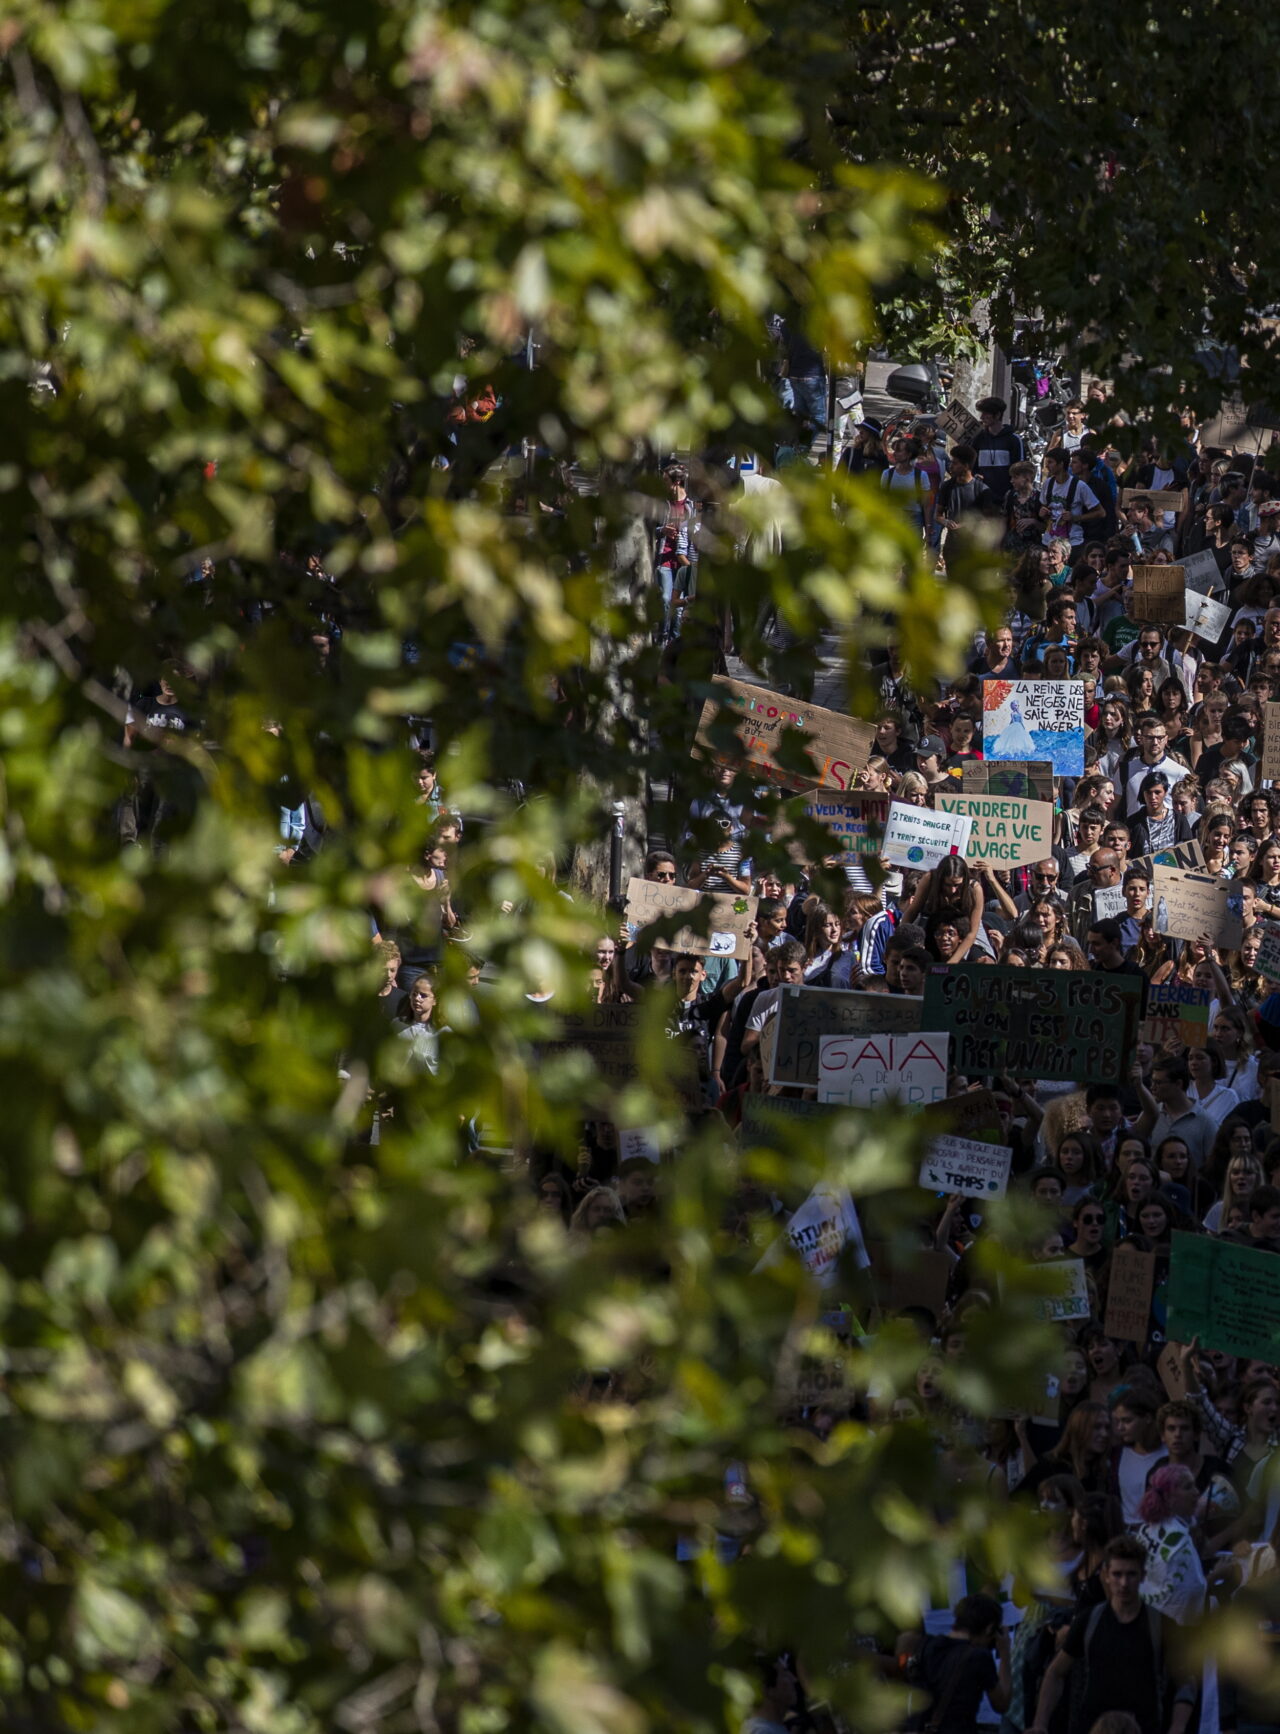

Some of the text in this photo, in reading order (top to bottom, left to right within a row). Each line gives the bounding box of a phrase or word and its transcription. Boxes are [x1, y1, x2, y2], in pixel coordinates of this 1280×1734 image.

[1015, 681, 1029, 695] LA
[1068, 699, 1084, 710] NE
[742, 715, 763, 729] may
[1038, 721, 1074, 733] NAGER
[815, 804, 843, 817] VEUX
[941, 799, 1028, 821] VENDREDI
[922, 819, 952, 833] DANGER
[985, 820, 1043, 842] LA VIE
[838, 835, 880, 853] CLIMA
[896, 832, 916, 843] TRAIT
[966, 840, 1022, 861] UVAGE
[942, 973, 1122, 1016] ÇA FAIT 3 FOIS
[1149, 984, 1211, 1006] TERRIEN
[1146, 1002, 1181, 1018] SANS
[1028, 1013, 1066, 1038] EST
[820, 1038, 946, 1072] GAIA
[1084, 1046, 1119, 1079] PB
[850, 1070, 913, 1086] A DE LA
[993, 1146, 1009, 1158] LES
[945, 1171, 985, 1191] TEMPS
[991, 1170, 1004, 1179] DU
